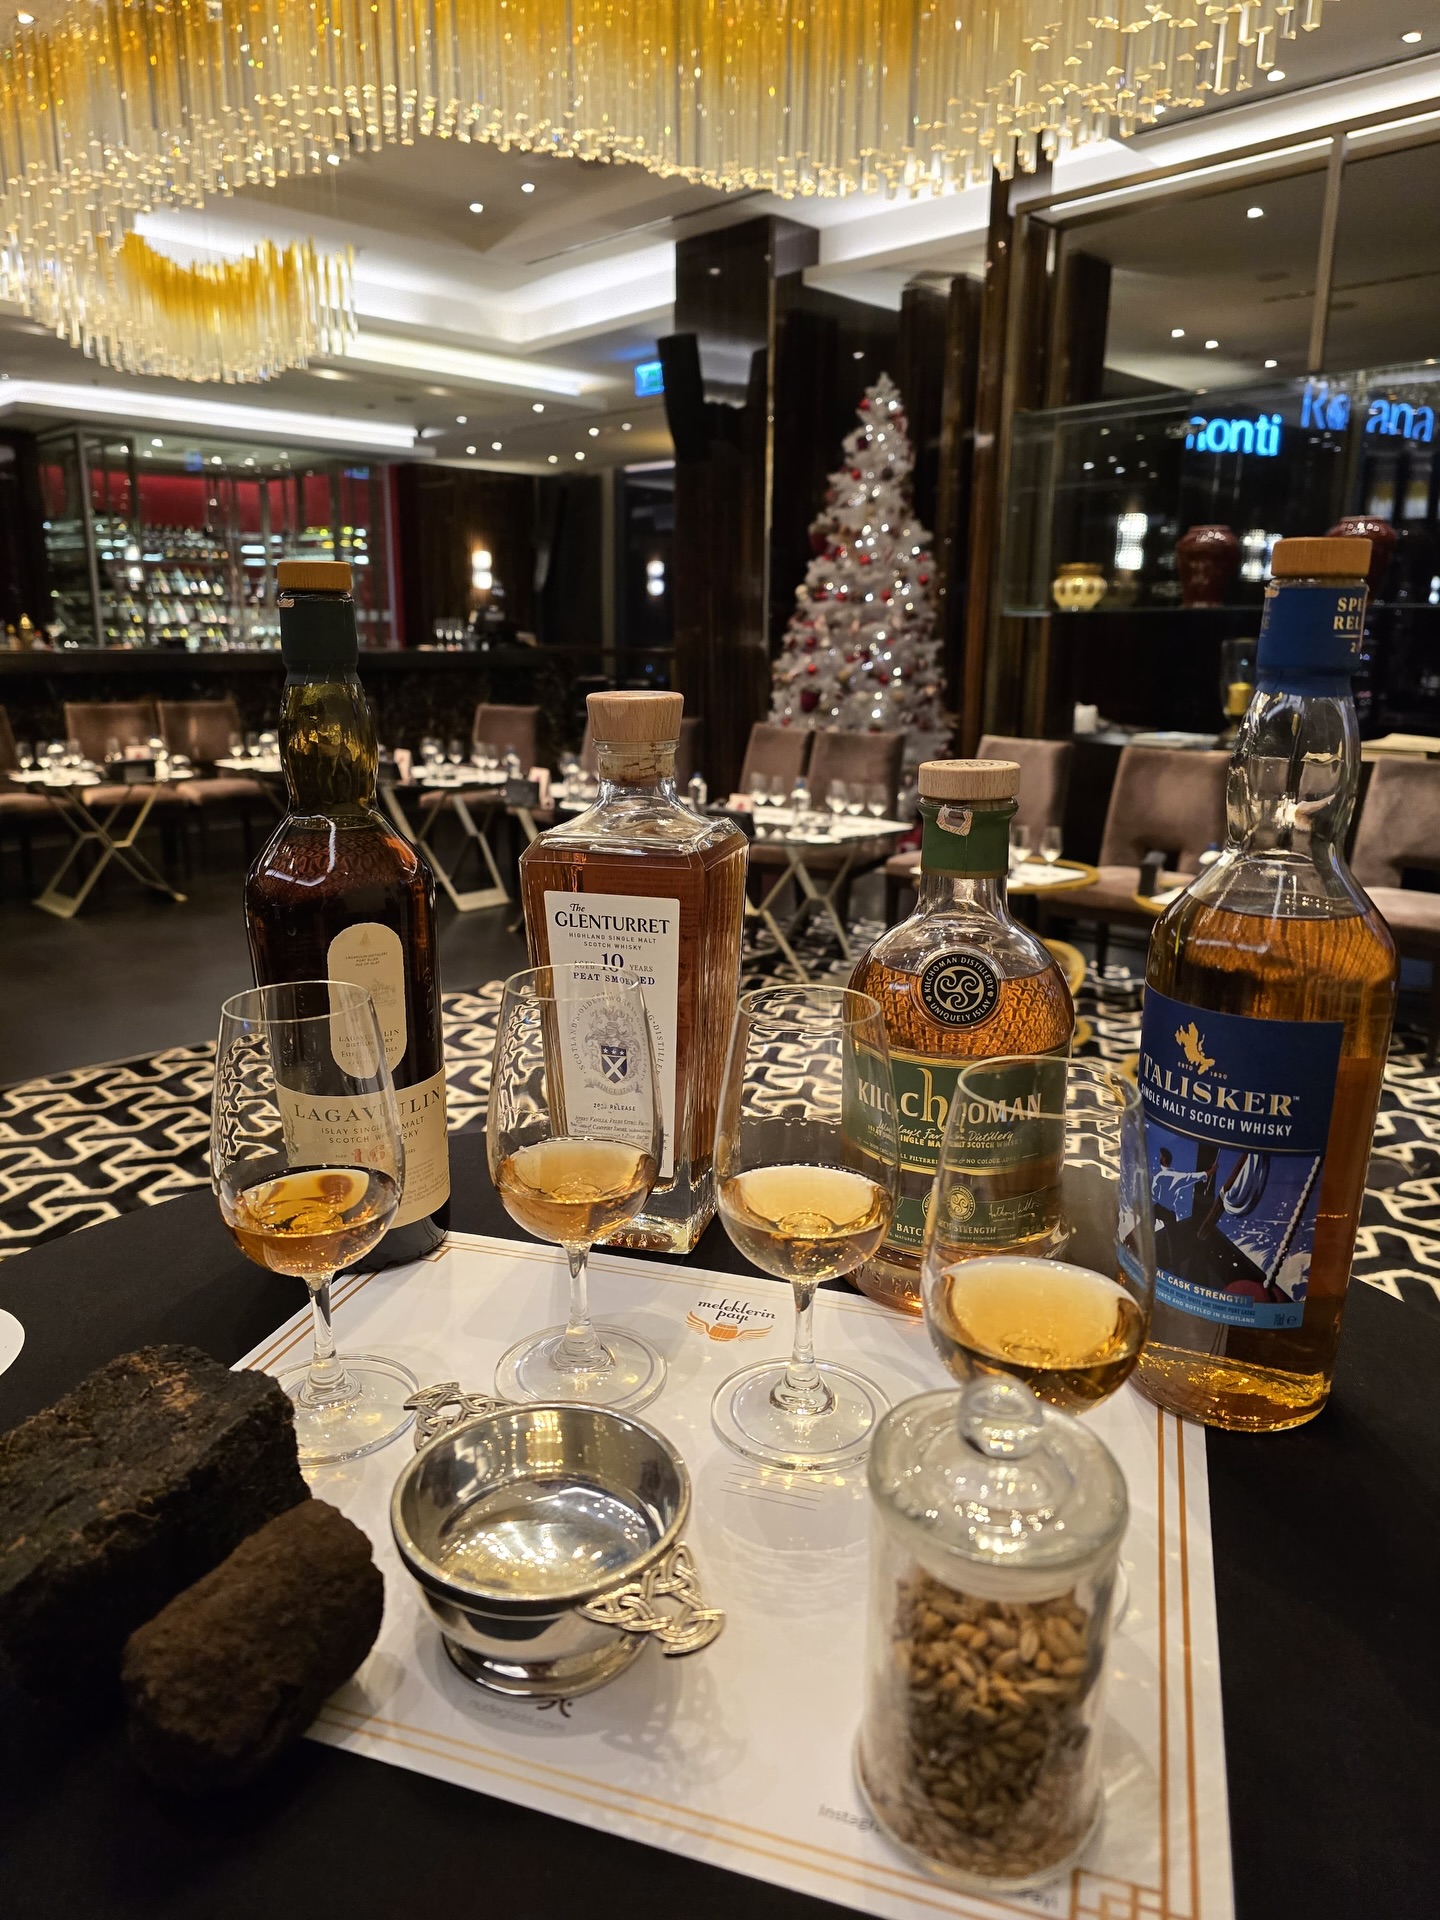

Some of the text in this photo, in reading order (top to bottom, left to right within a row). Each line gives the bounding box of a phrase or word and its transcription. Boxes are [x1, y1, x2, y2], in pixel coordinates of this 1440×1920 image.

[569, 903, 586, 912] The
[554, 911, 671, 934] GLENTURRET
[568, 932, 606, 940] HIGHLAND
[638, 936, 657, 944] MALT
[614, 943, 642, 951] WHISKY
[600, 953, 625, 973] 10
[629, 964, 654, 973] YEARS
[573, 972, 601, 982] PEAT
[925, 956, 994, 992] KILCHOMAN DISTILLERY
[931, 998, 992, 1022] UNIQUELY ISLAY
[1177, 1061, 1228, 1080] ESTD 1830
[1143, 1052, 1293, 1117] TALISKER
[1141, 1082, 1293, 1137] SINGLE MALT SCOTCH WHISKY
[321, 1127, 348, 1135] ISLAY
[401, 1116, 425, 1130] MALT
[329, 1136, 370, 1144] SCOTCH
[967, 1141, 995, 1149] SCOTCH
[354, 1144, 386, 1164] 16
[1168, 1276, 1191, 1291] CASK
[1193, 1286, 1248, 1306] STRENGTH
[697, 1299, 777, 1320] meleklerin
[1185, 1303, 1211, 1316] BOTTLED
[1222, 1313, 1255, 1324] SCOTLAND
